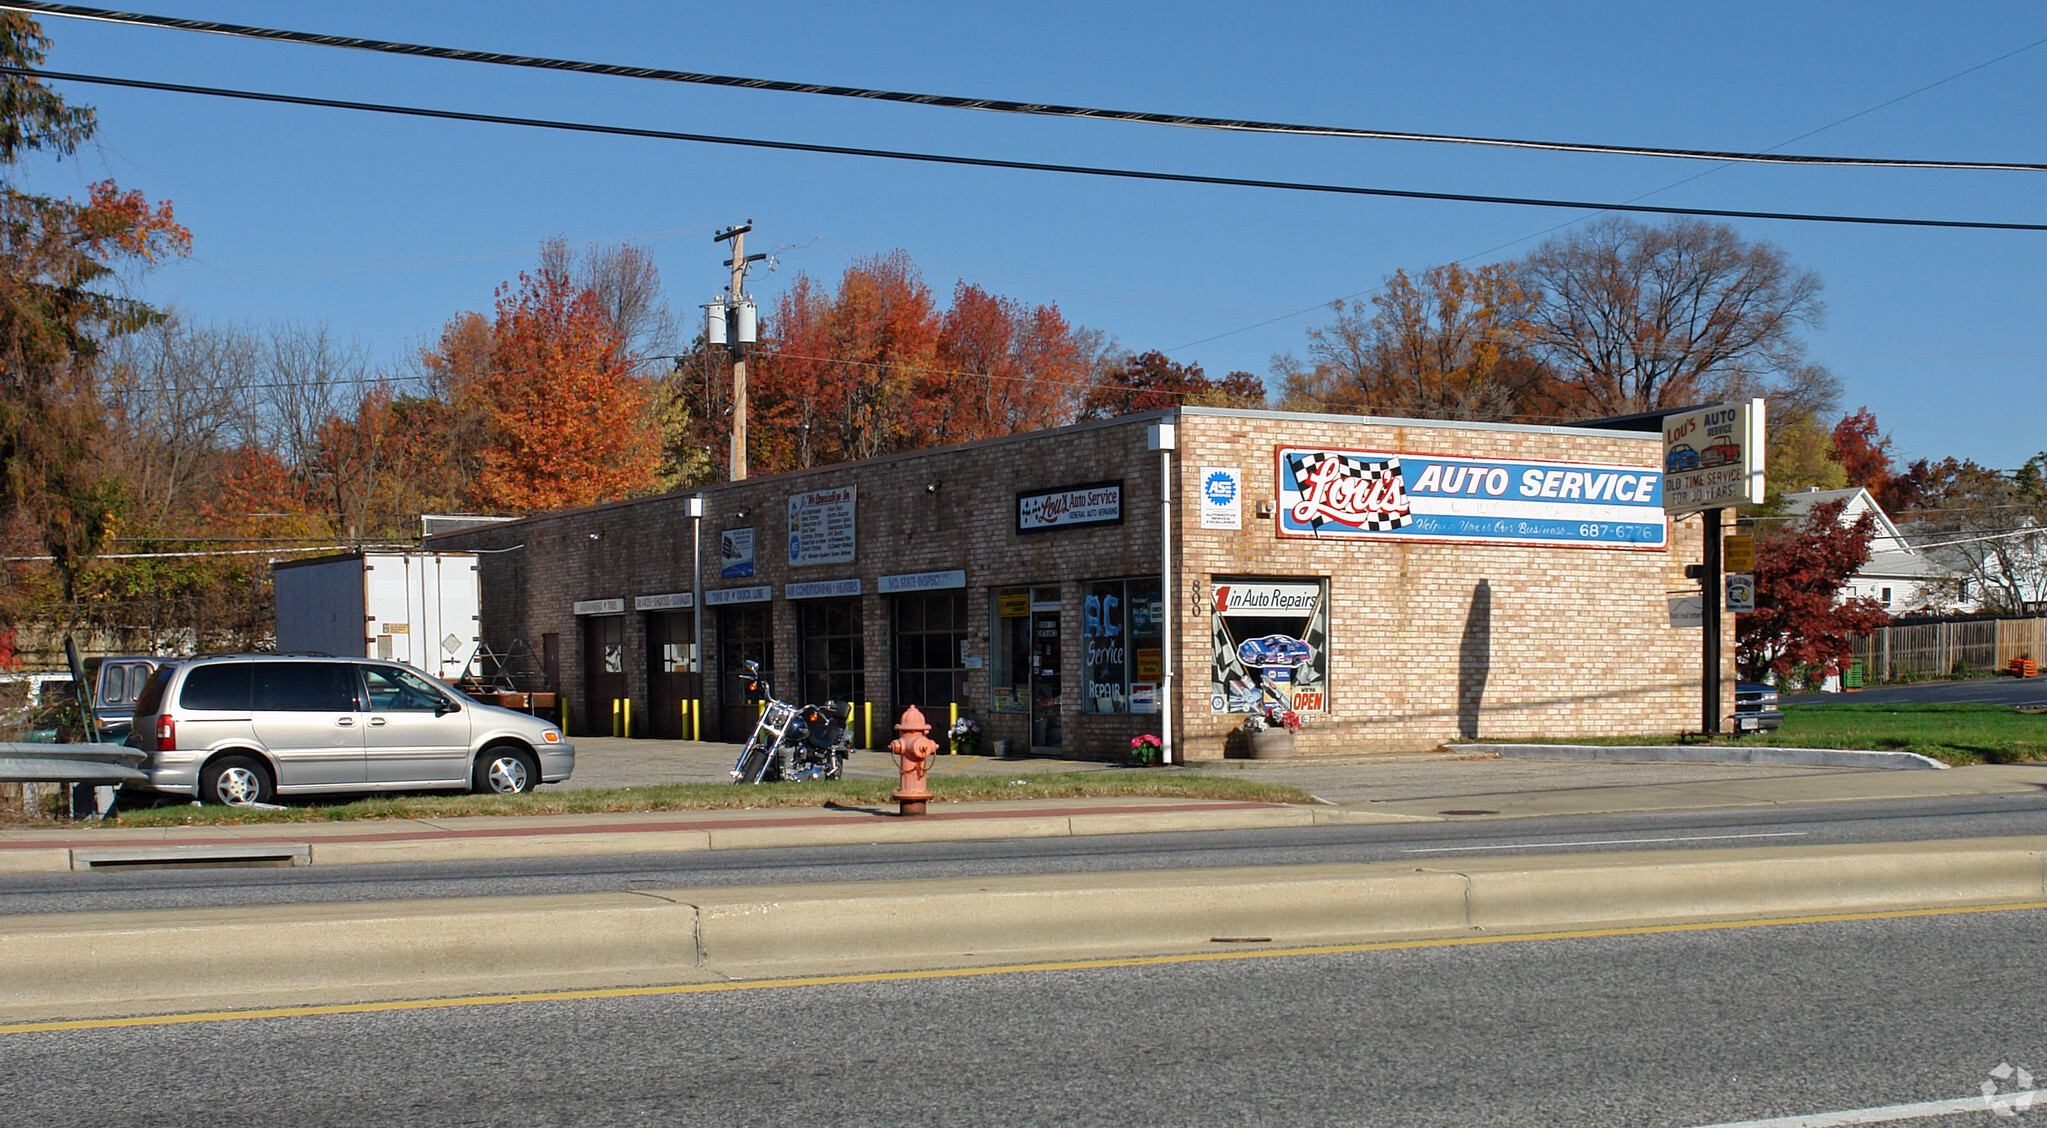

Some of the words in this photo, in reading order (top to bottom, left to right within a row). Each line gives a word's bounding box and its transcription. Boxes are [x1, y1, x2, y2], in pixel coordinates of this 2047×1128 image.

[1667, 418, 1696, 445] LOU'S
[1703, 409, 1736, 427] AUTO
[1707, 424, 1732, 437] SERVICE
[1208, 480, 1232, 494] ASE
[1411, 464, 1509, 496] AUTO
[1519, 469, 1658, 502] SERVICE
[1666, 478, 1681, 491] OLD
[1685, 475, 1704, 489] TIME
[1706, 467, 1742, 486] SERVICE
[1291, 456, 1411, 527] Lou's
[1672, 492, 1688, 504] FOR
[1692, 489, 1702, 503] 30
[1038, 494, 1070, 523] Lou's
[1069, 494, 1086, 508] Auto
[1087, 489, 1117, 506] Service
[1579, 524, 1653, 539] 687-6776
[1191, 580, 1201, 617] 800
[1230, 590, 1242, 607] in
[1242, 589, 1269, 607] Auto
[1271, 589, 1318, 611] Repairs
[1087, 639, 1124, 667] Service
[1089, 680, 1121, 699] REPAIR
[1293, 693, 1322, 710] OPEN
